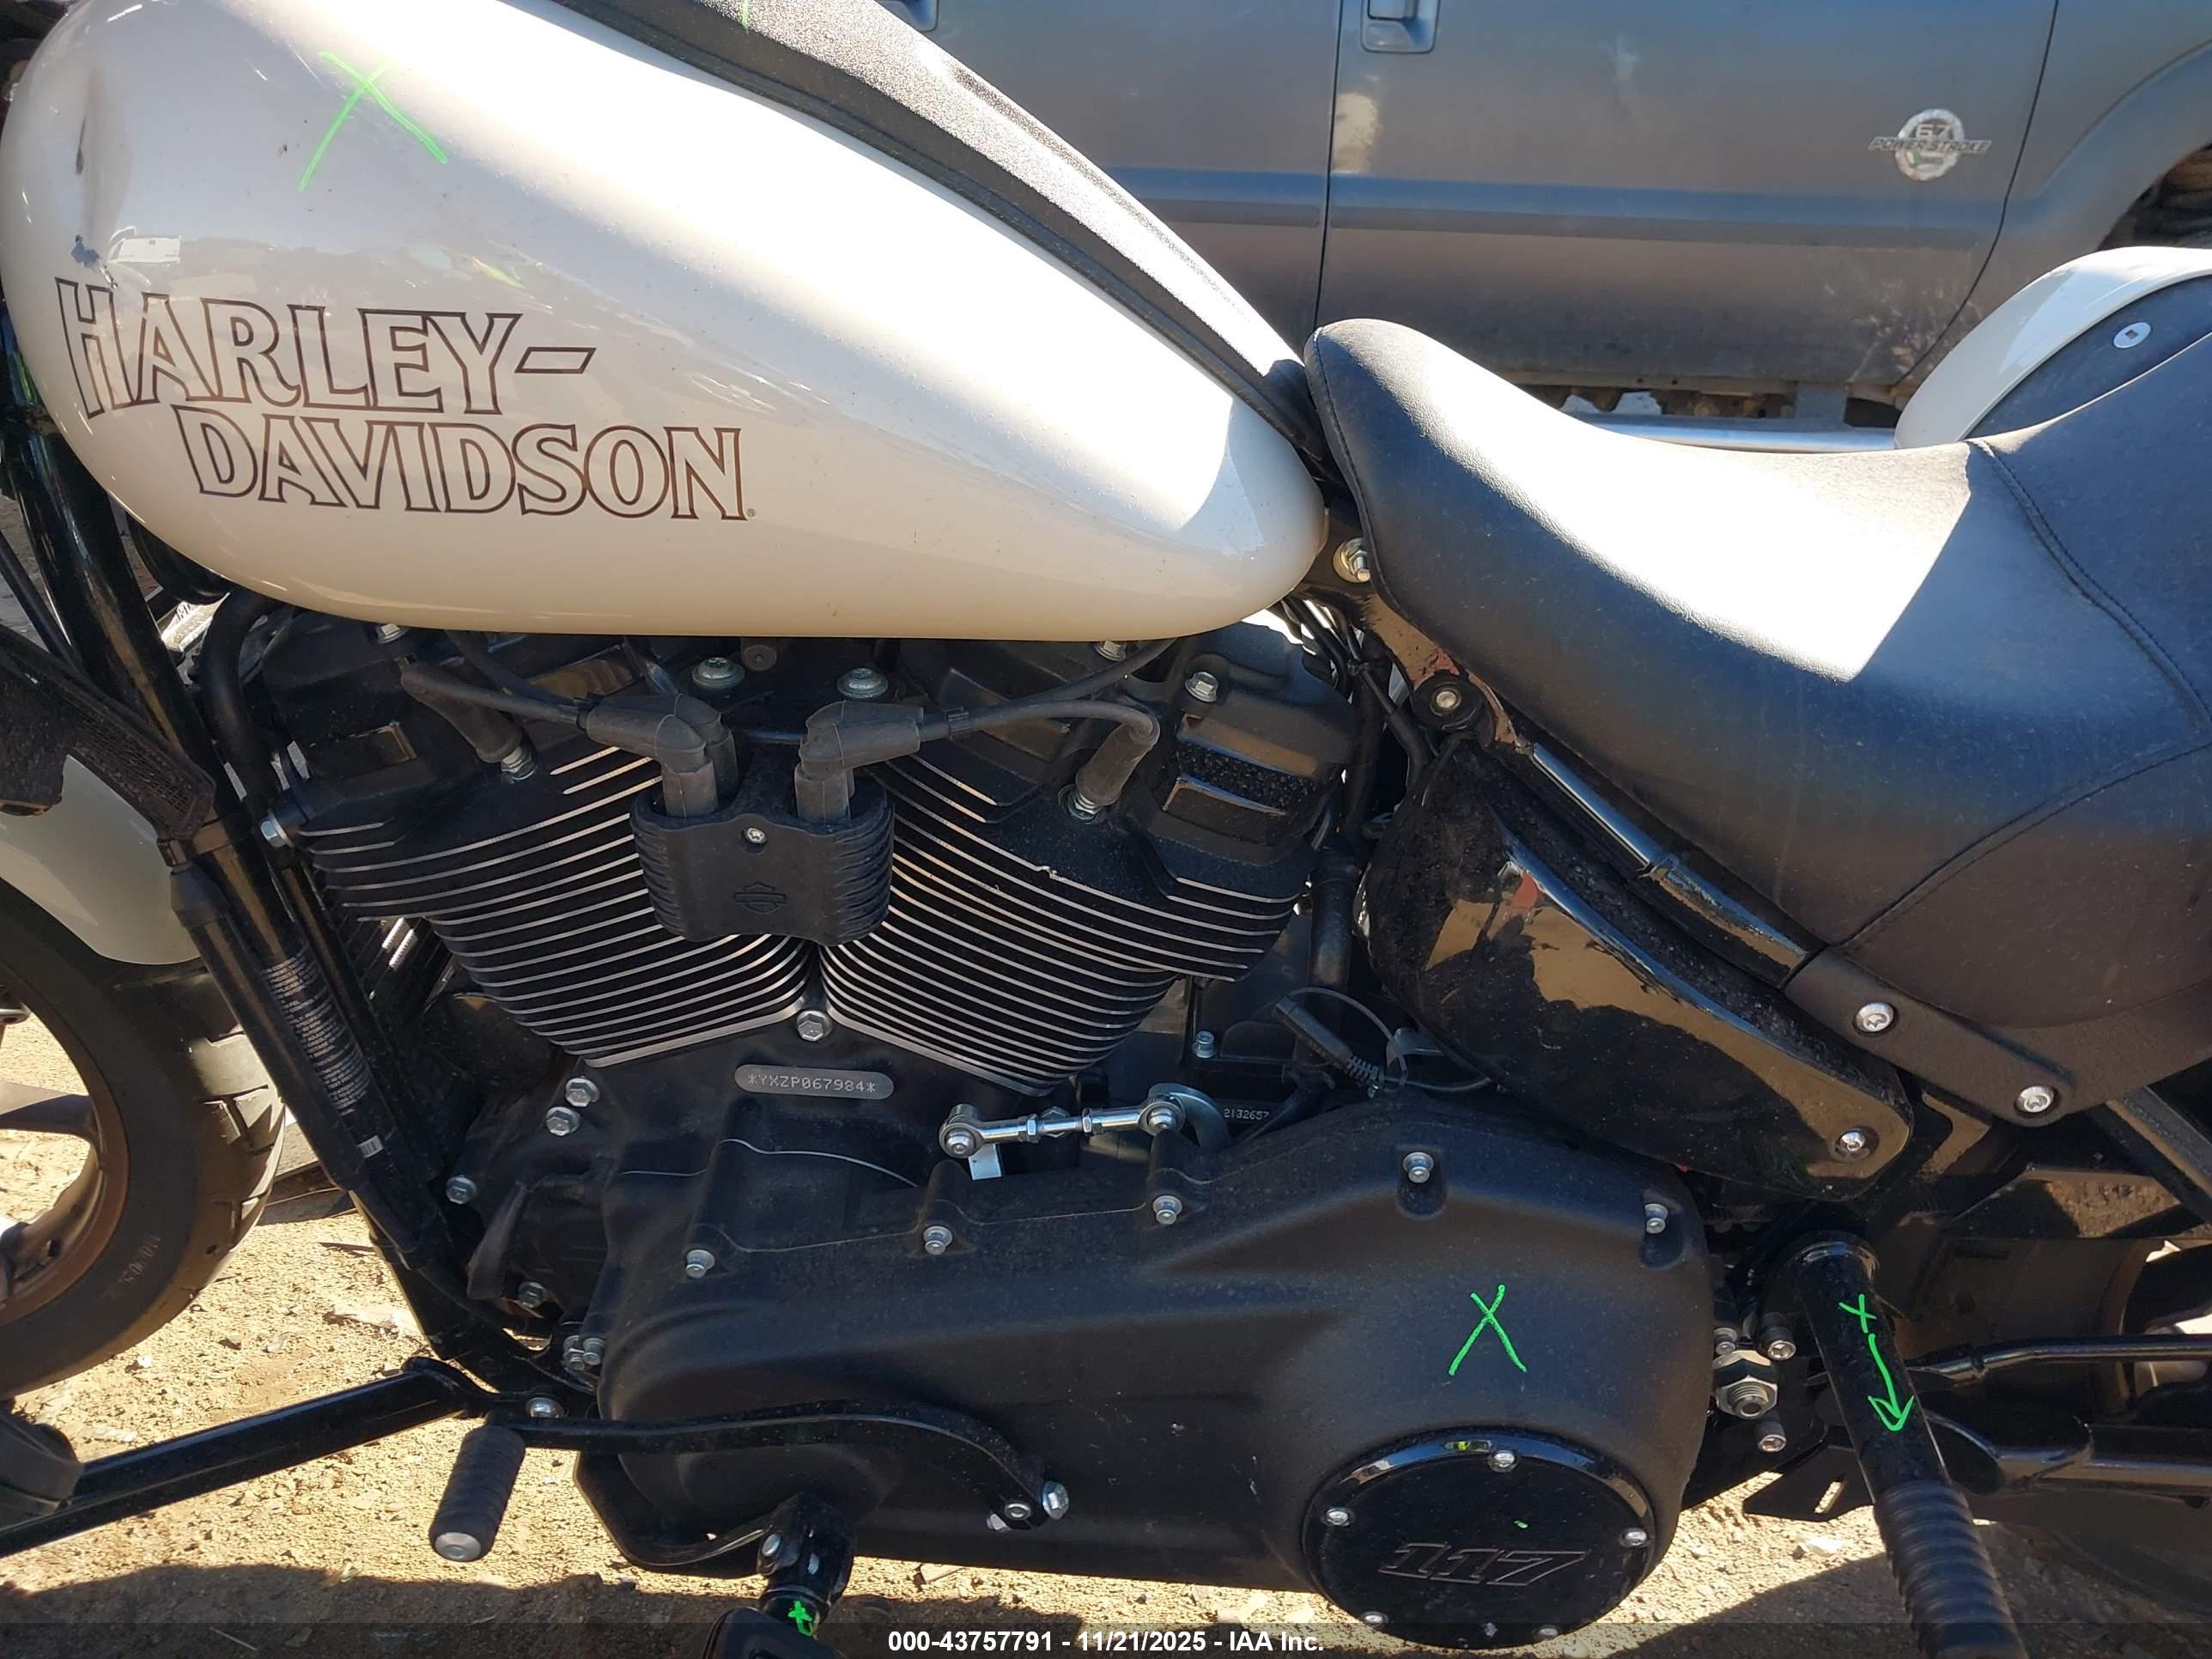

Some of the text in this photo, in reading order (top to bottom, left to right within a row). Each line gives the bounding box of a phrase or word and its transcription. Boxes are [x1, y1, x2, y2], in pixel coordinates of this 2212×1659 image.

[55, 276, 597, 418] HARLEY-
[173, 404, 748, 521] DAVIDSON
[1377, 1542, 1590, 1586] 117
